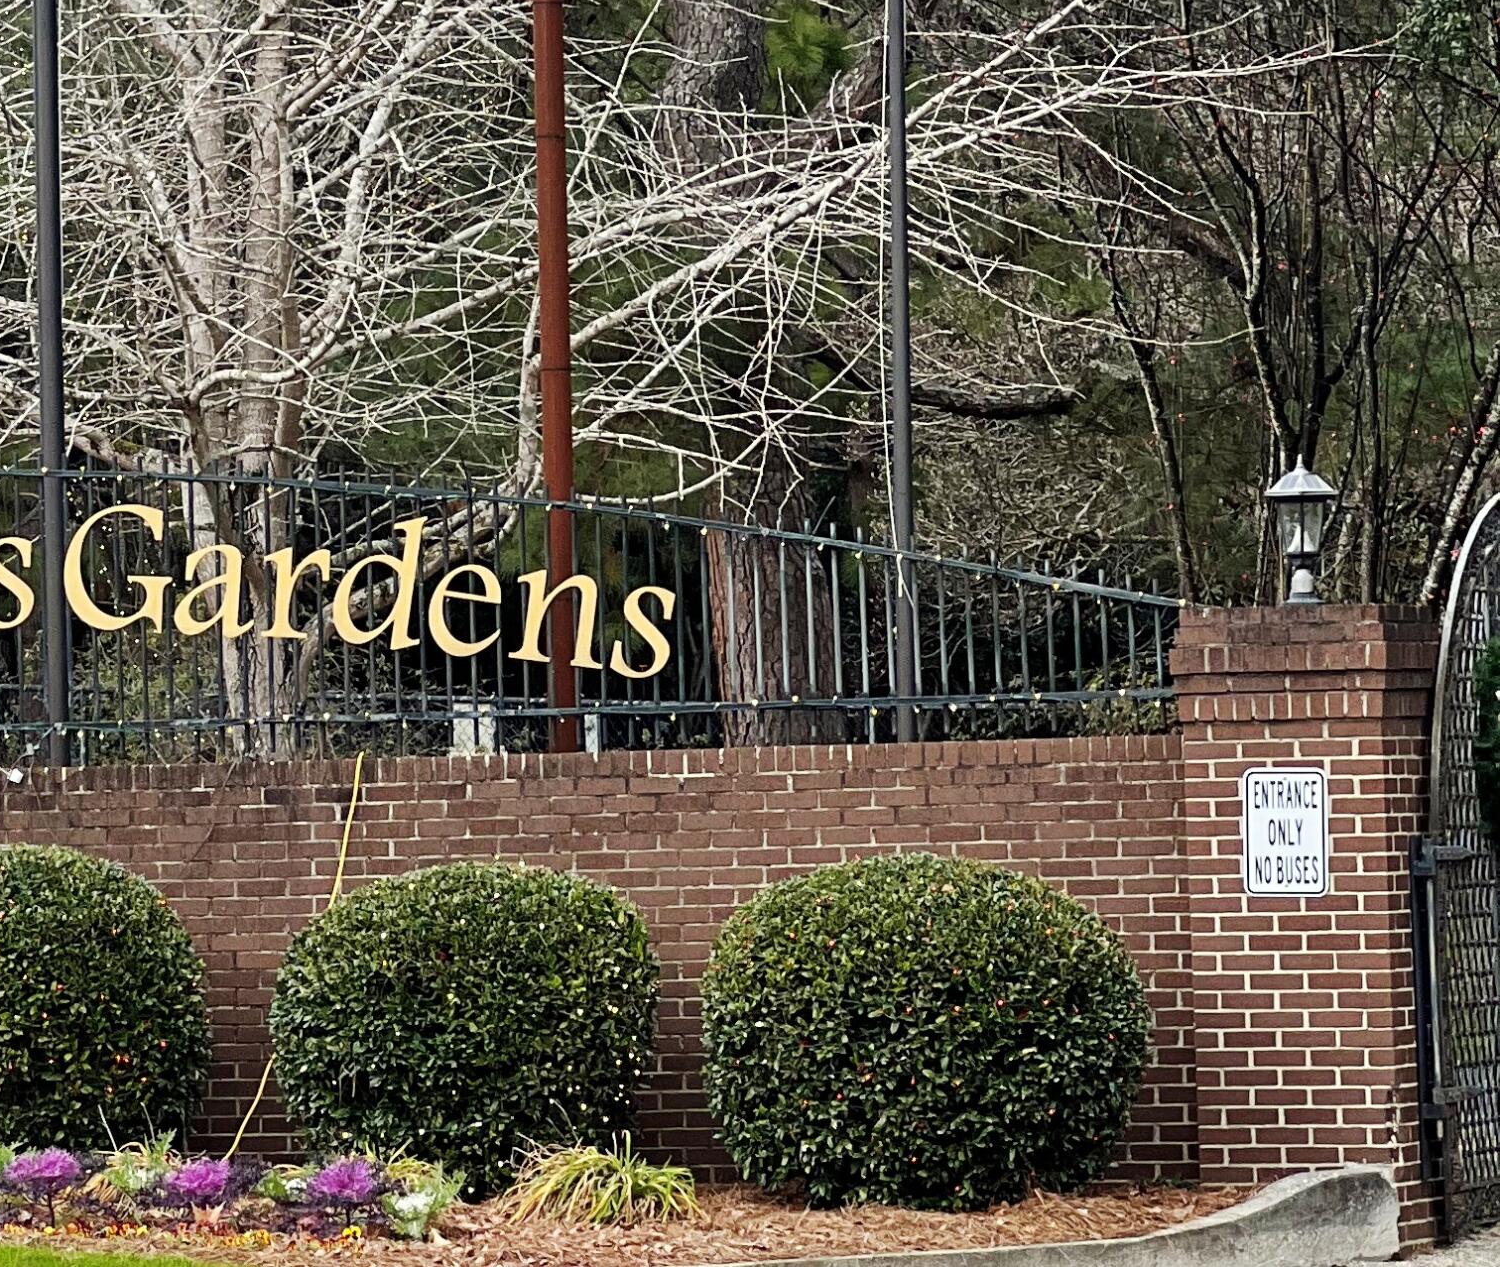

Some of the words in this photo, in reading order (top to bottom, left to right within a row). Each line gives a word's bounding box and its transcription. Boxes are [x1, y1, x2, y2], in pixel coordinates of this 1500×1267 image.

[64, 504, 675, 679] Gardens
[1254, 780, 1318, 809] ENTRANCE
[1268, 818, 1303, 846] ONLY
[1255, 856, 1272, 884] NO
[1276, 856, 1319, 884] BUSES
